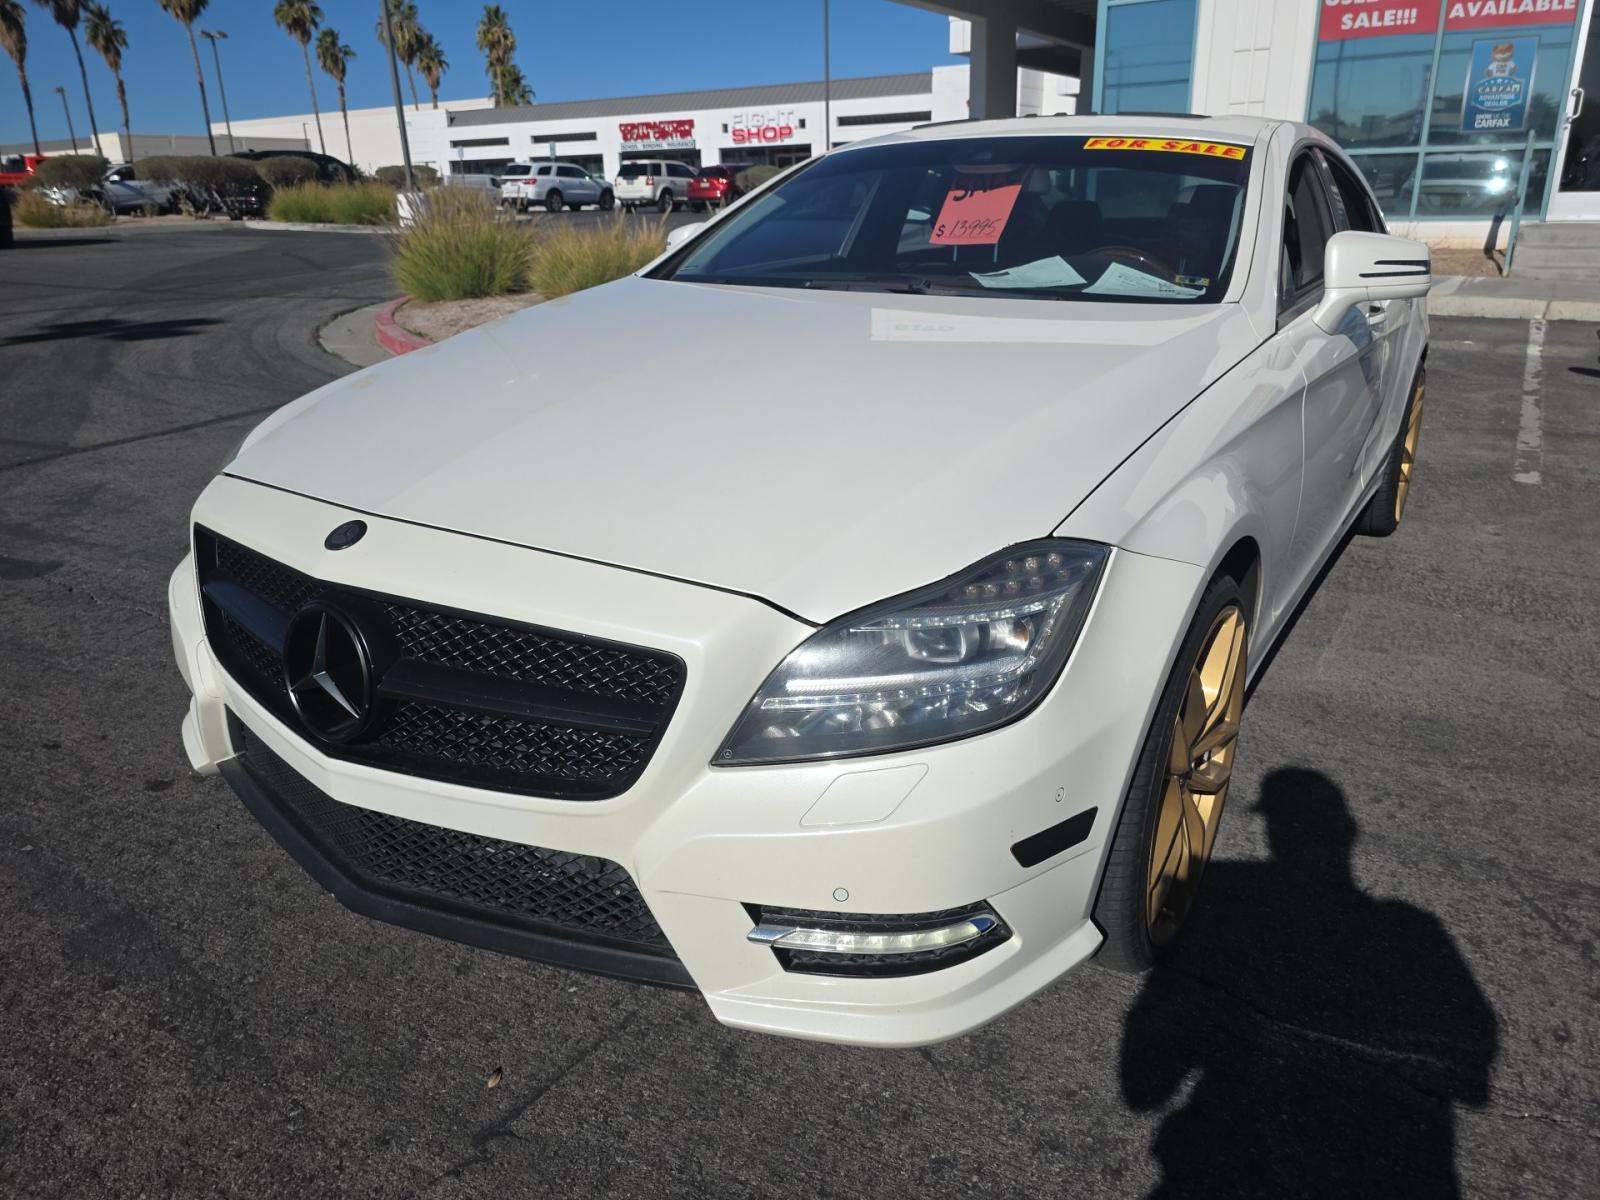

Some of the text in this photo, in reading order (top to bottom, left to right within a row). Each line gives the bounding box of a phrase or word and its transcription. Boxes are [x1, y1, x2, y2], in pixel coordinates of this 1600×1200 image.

[1448, 0, 1576, 18] AVAILABLE
[1341, 8, 1417, 30] SALE!!!
[733, 110, 794, 129] FIGHT
[1474, 118, 1510, 128] CARFAX
[732, 125, 793, 144] SHOP
[1087, 138, 1242, 157] FOR SALE
